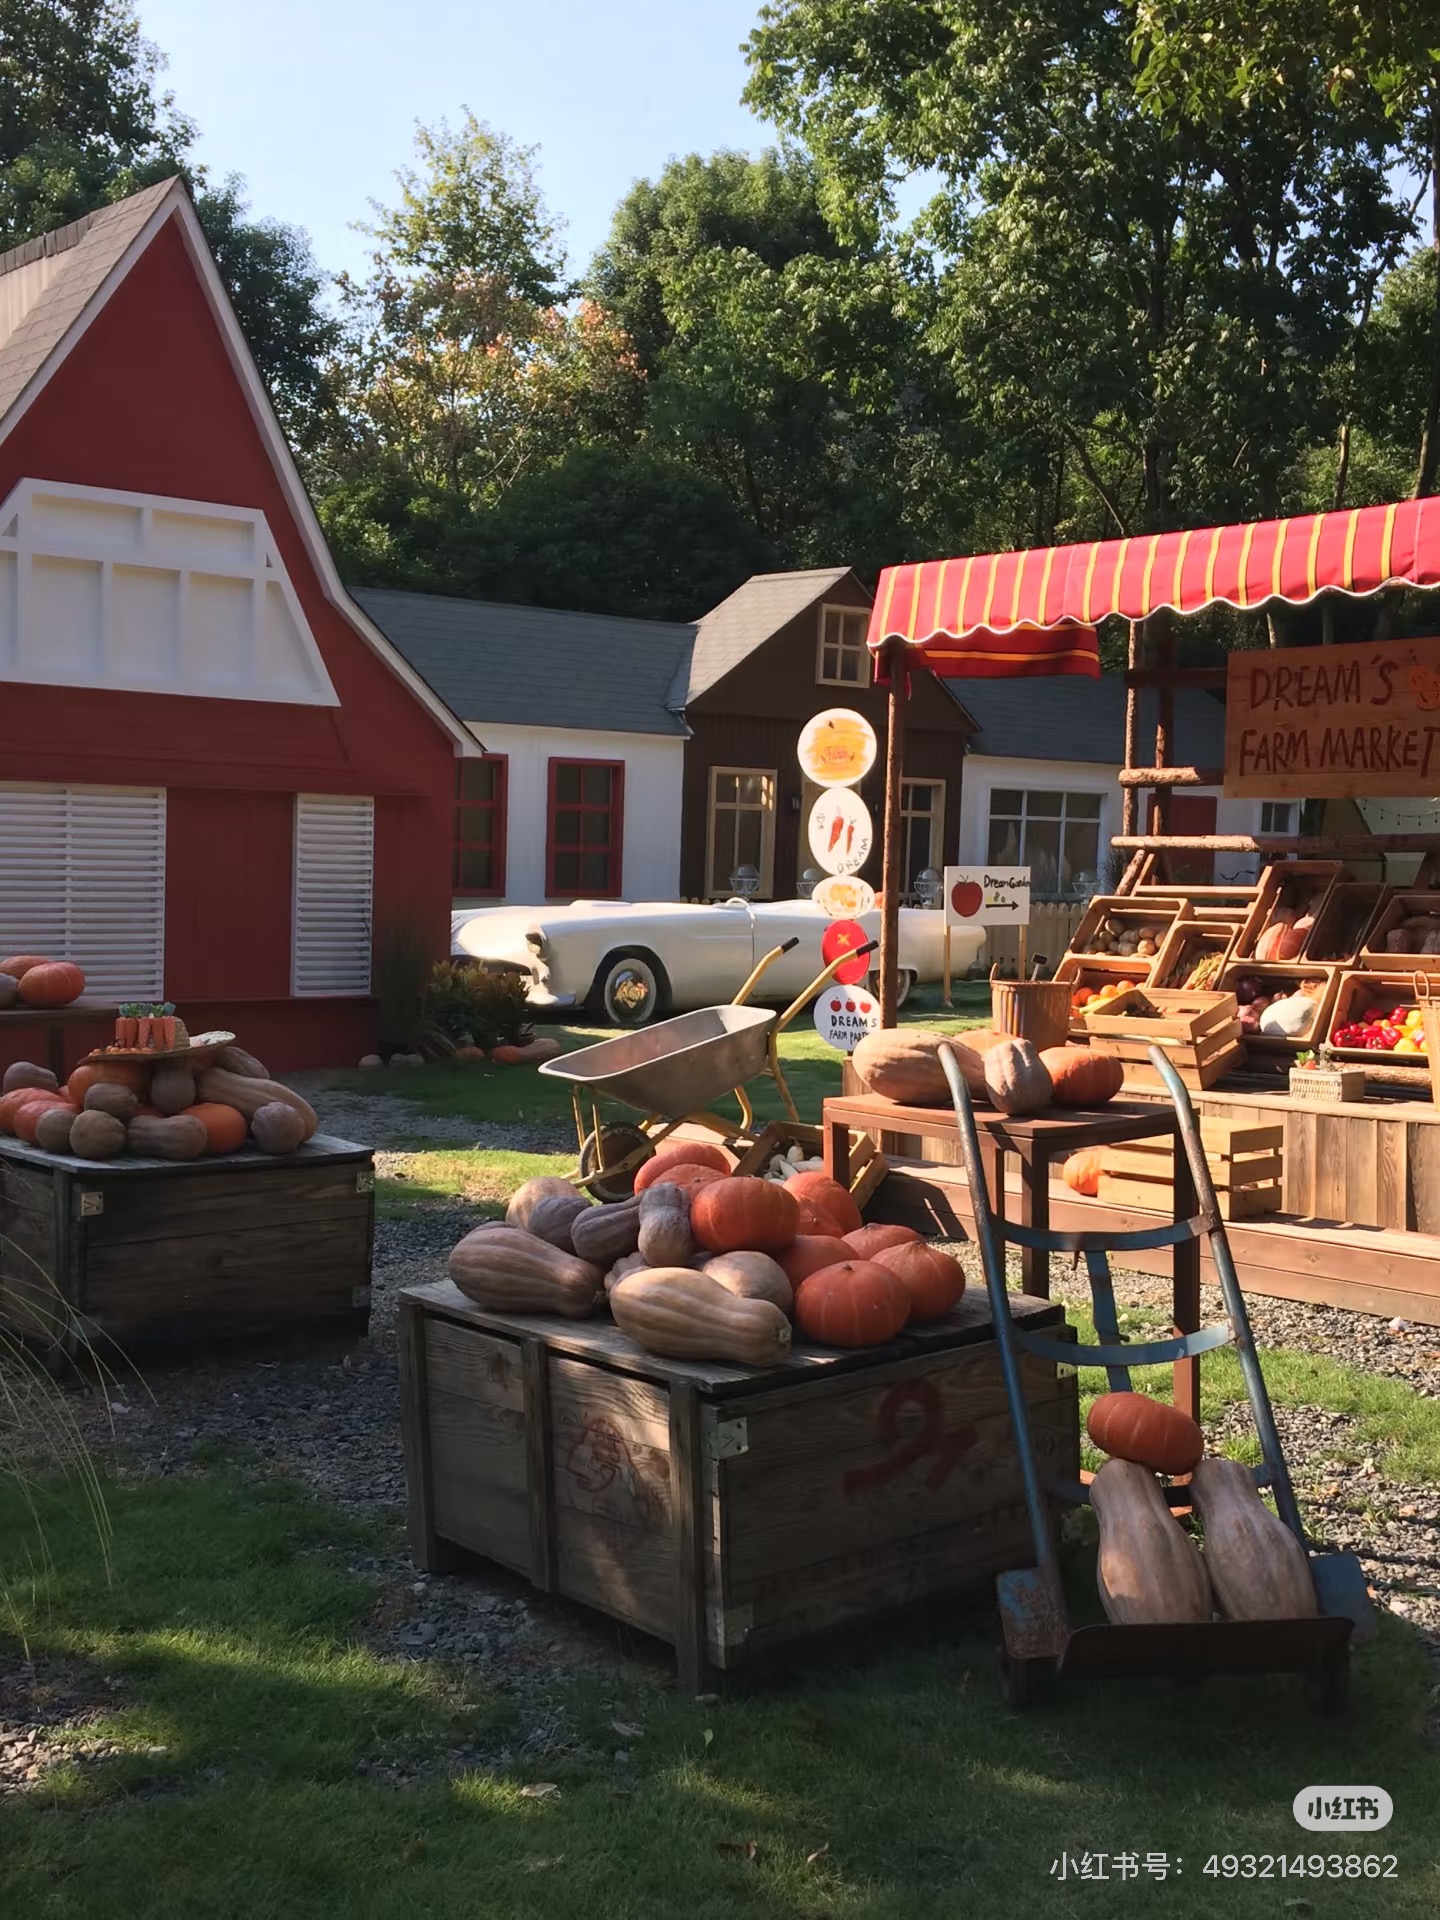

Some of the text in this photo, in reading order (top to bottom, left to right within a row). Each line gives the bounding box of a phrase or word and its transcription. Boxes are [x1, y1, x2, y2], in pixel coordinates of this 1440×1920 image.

[1239, 724, 1440, 777] FARM MARKET
[837, 838, 868, 873] DREAM
[829, 1029, 848, 1041] FARM
